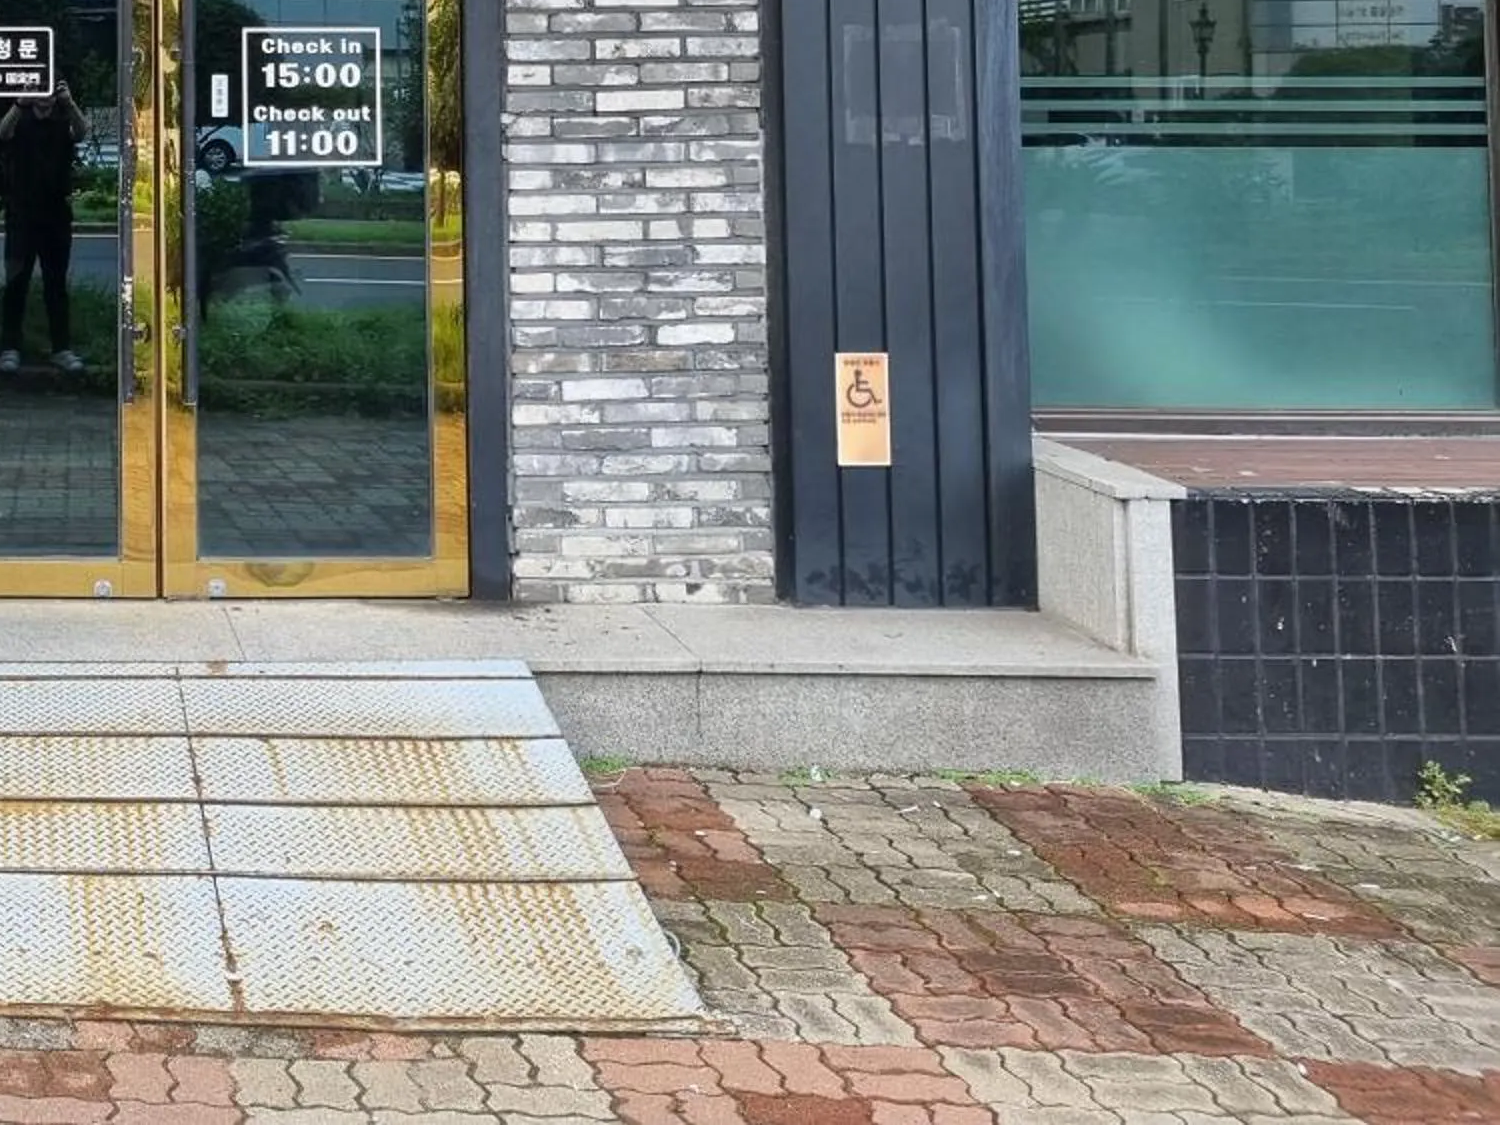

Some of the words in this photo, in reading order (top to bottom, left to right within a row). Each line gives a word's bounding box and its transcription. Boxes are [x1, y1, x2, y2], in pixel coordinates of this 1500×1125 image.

[261, 38, 333, 54] Check
[341, 38, 362, 54] in
[261, 62, 361, 88] 15:00
[253, 105, 325, 122] Check
[333, 105, 372, 122] out
[266, 130, 358, 156] 11:00
